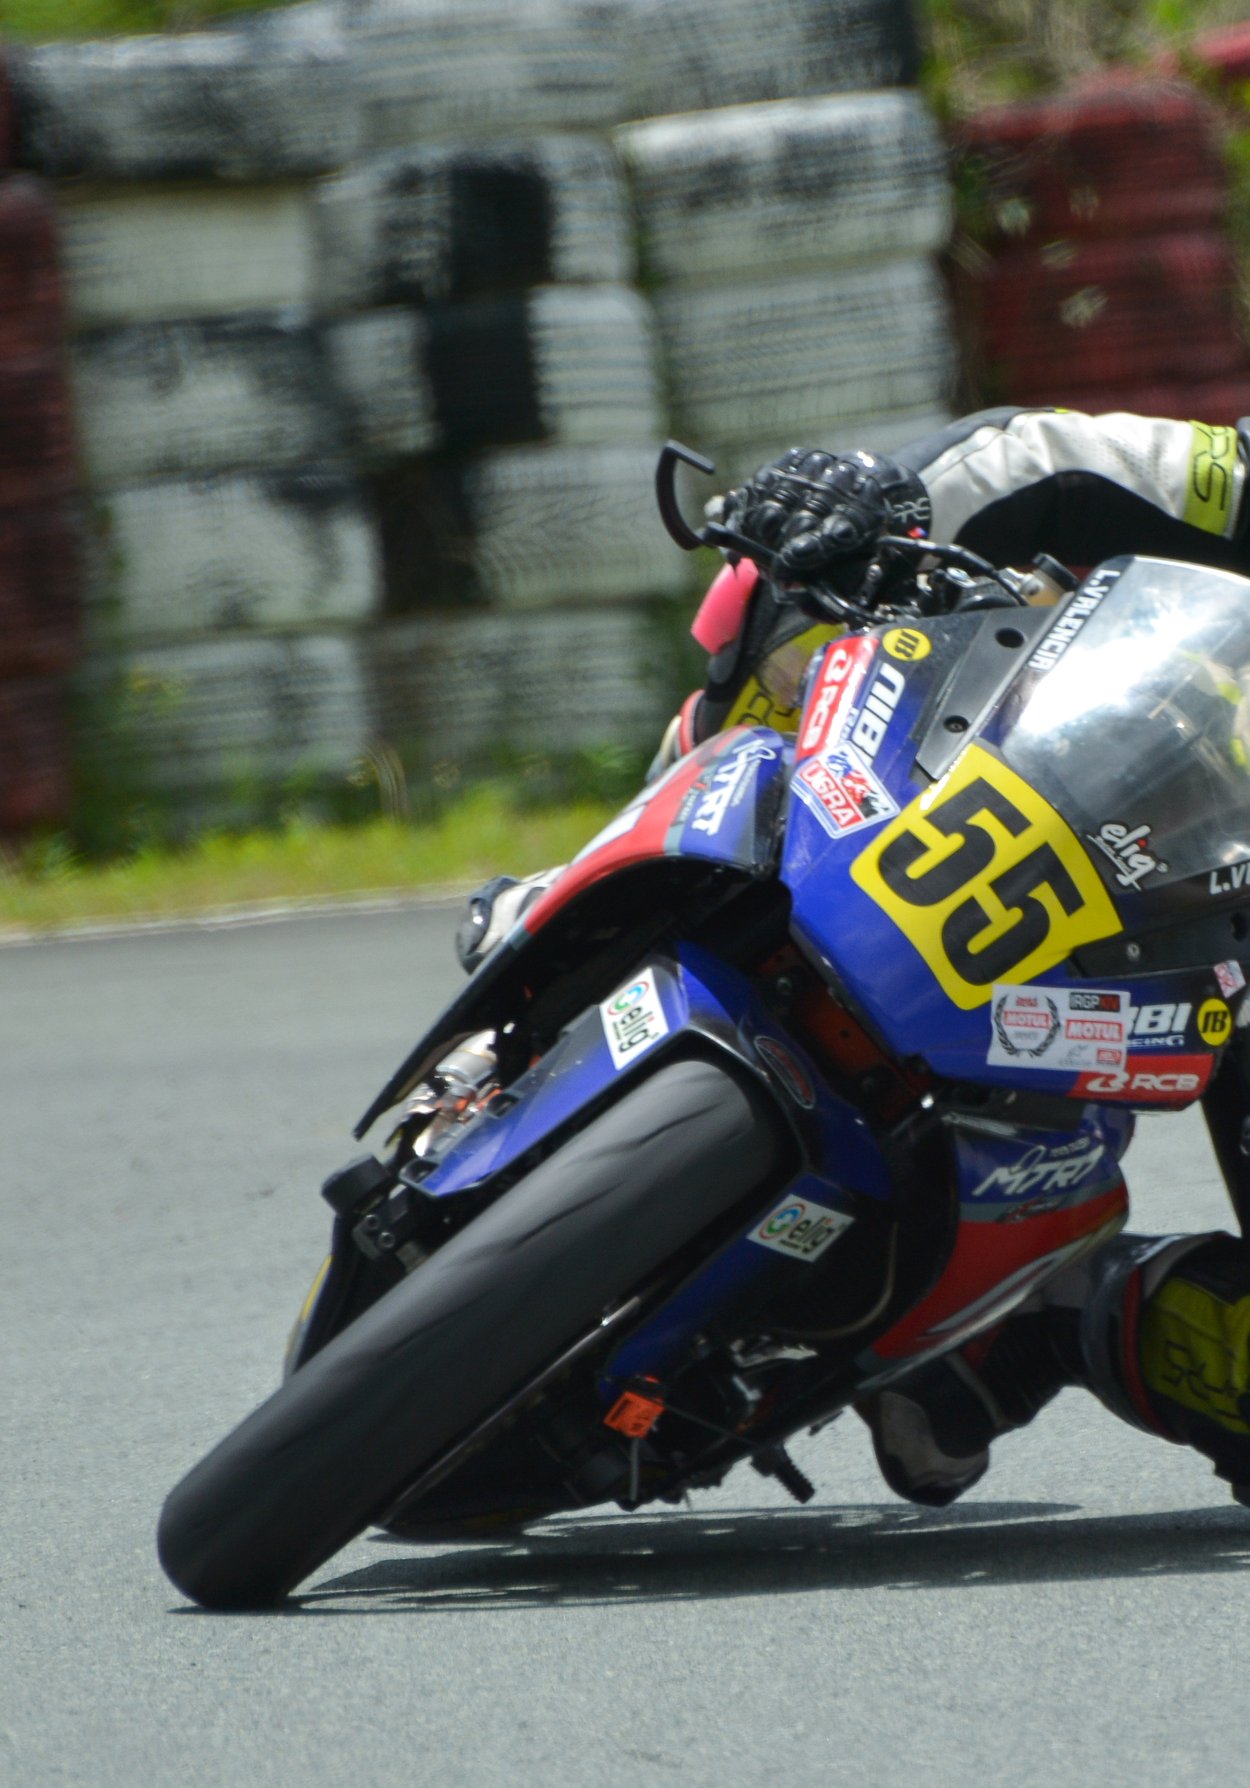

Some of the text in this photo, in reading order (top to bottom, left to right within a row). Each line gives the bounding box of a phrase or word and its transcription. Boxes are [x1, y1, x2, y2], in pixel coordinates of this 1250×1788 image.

[878, 776, 1086, 986] 55
[1006, 1012, 1050, 1028] MOTUL
[1066, 1020, 1122, 1042] MOTUL
[1130, 1073, 1200, 1092] RCB
